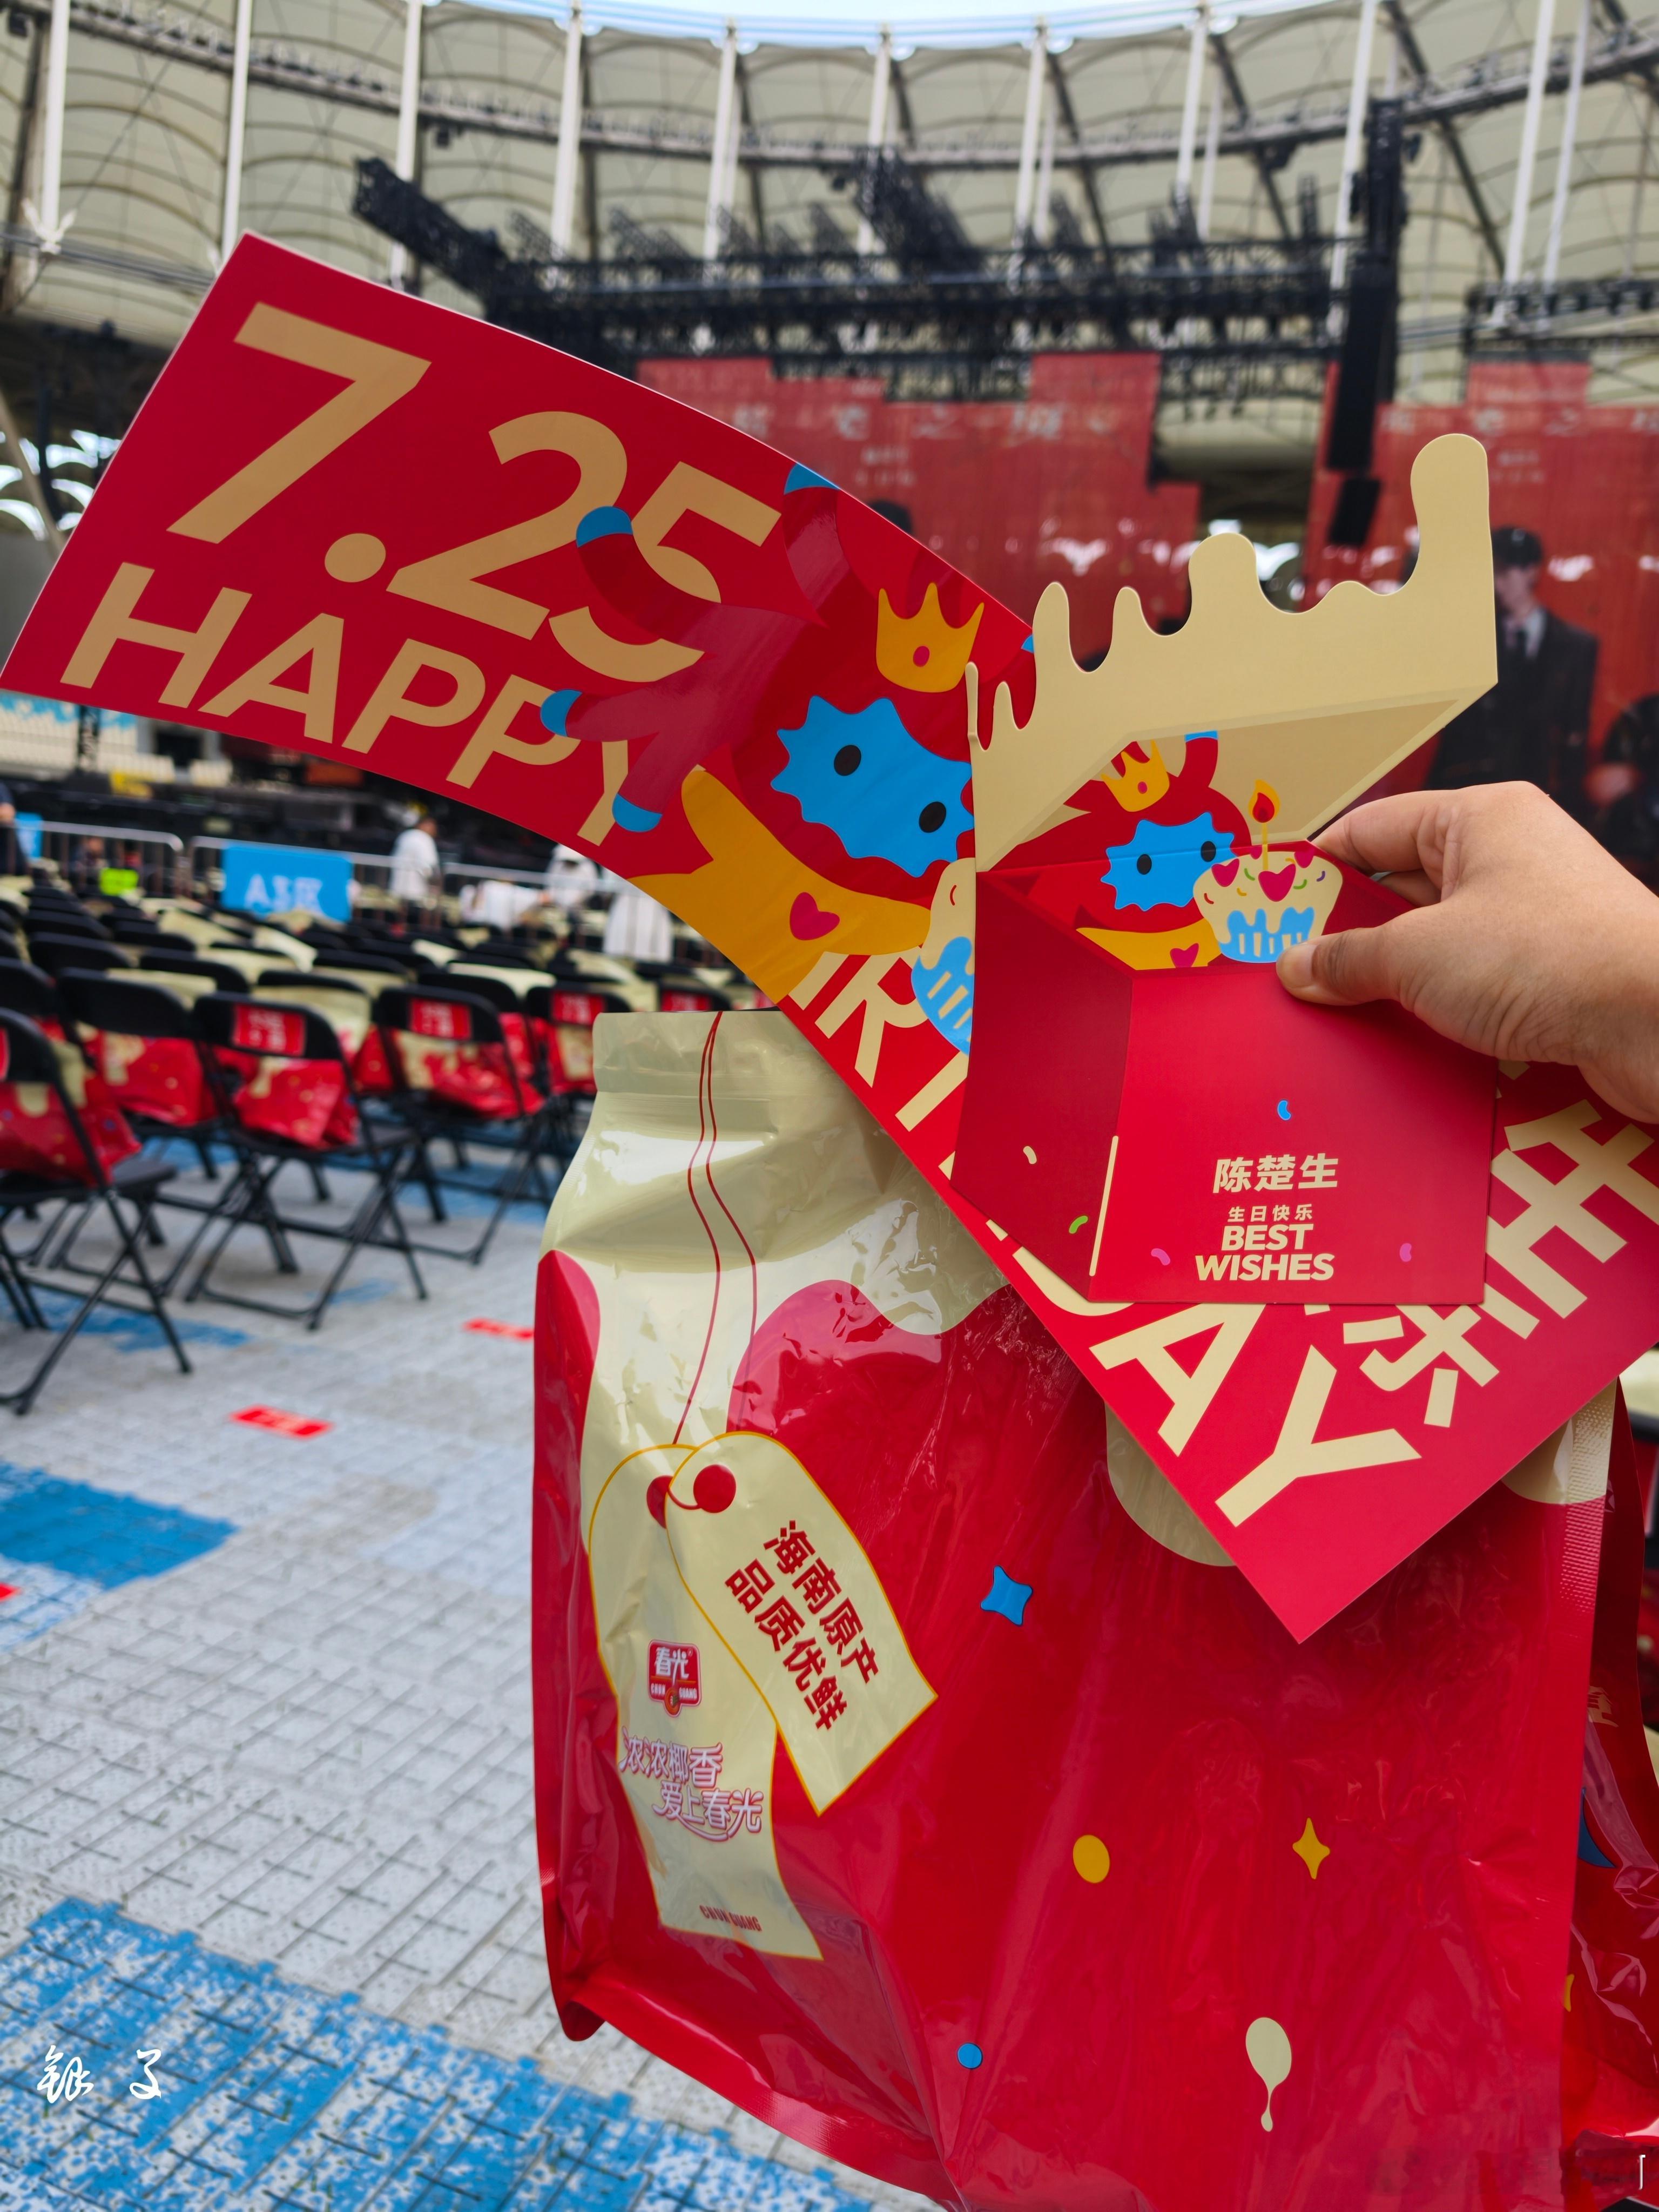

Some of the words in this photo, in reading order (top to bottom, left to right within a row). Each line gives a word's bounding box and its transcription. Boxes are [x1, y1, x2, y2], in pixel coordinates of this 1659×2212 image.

[166, 301, 782, 683] 7.25
[59, 562, 706, 846] HAPPY
[1212, 1152, 1339, 1193] 陈楚生
[1227, 1203, 1313, 1223] 生日快乐
[1221, 1223, 1314, 1251] BEST
[1195, 1253, 1336, 1282] WISHES
[763, 1520, 879, 1684] 海南原产
[724, 1558, 847, 1730] 品质优鲜
[654, 1647, 690, 1685] 春光
[651, 1683, 665, 1696] CHUN
[679, 1688, 697, 1700] GUANG
[618, 1725, 724, 1789] 浓浓椰香
[651, 1779, 764, 1842] 爱上春光
[699, 1904, 730, 1924] CHUN
